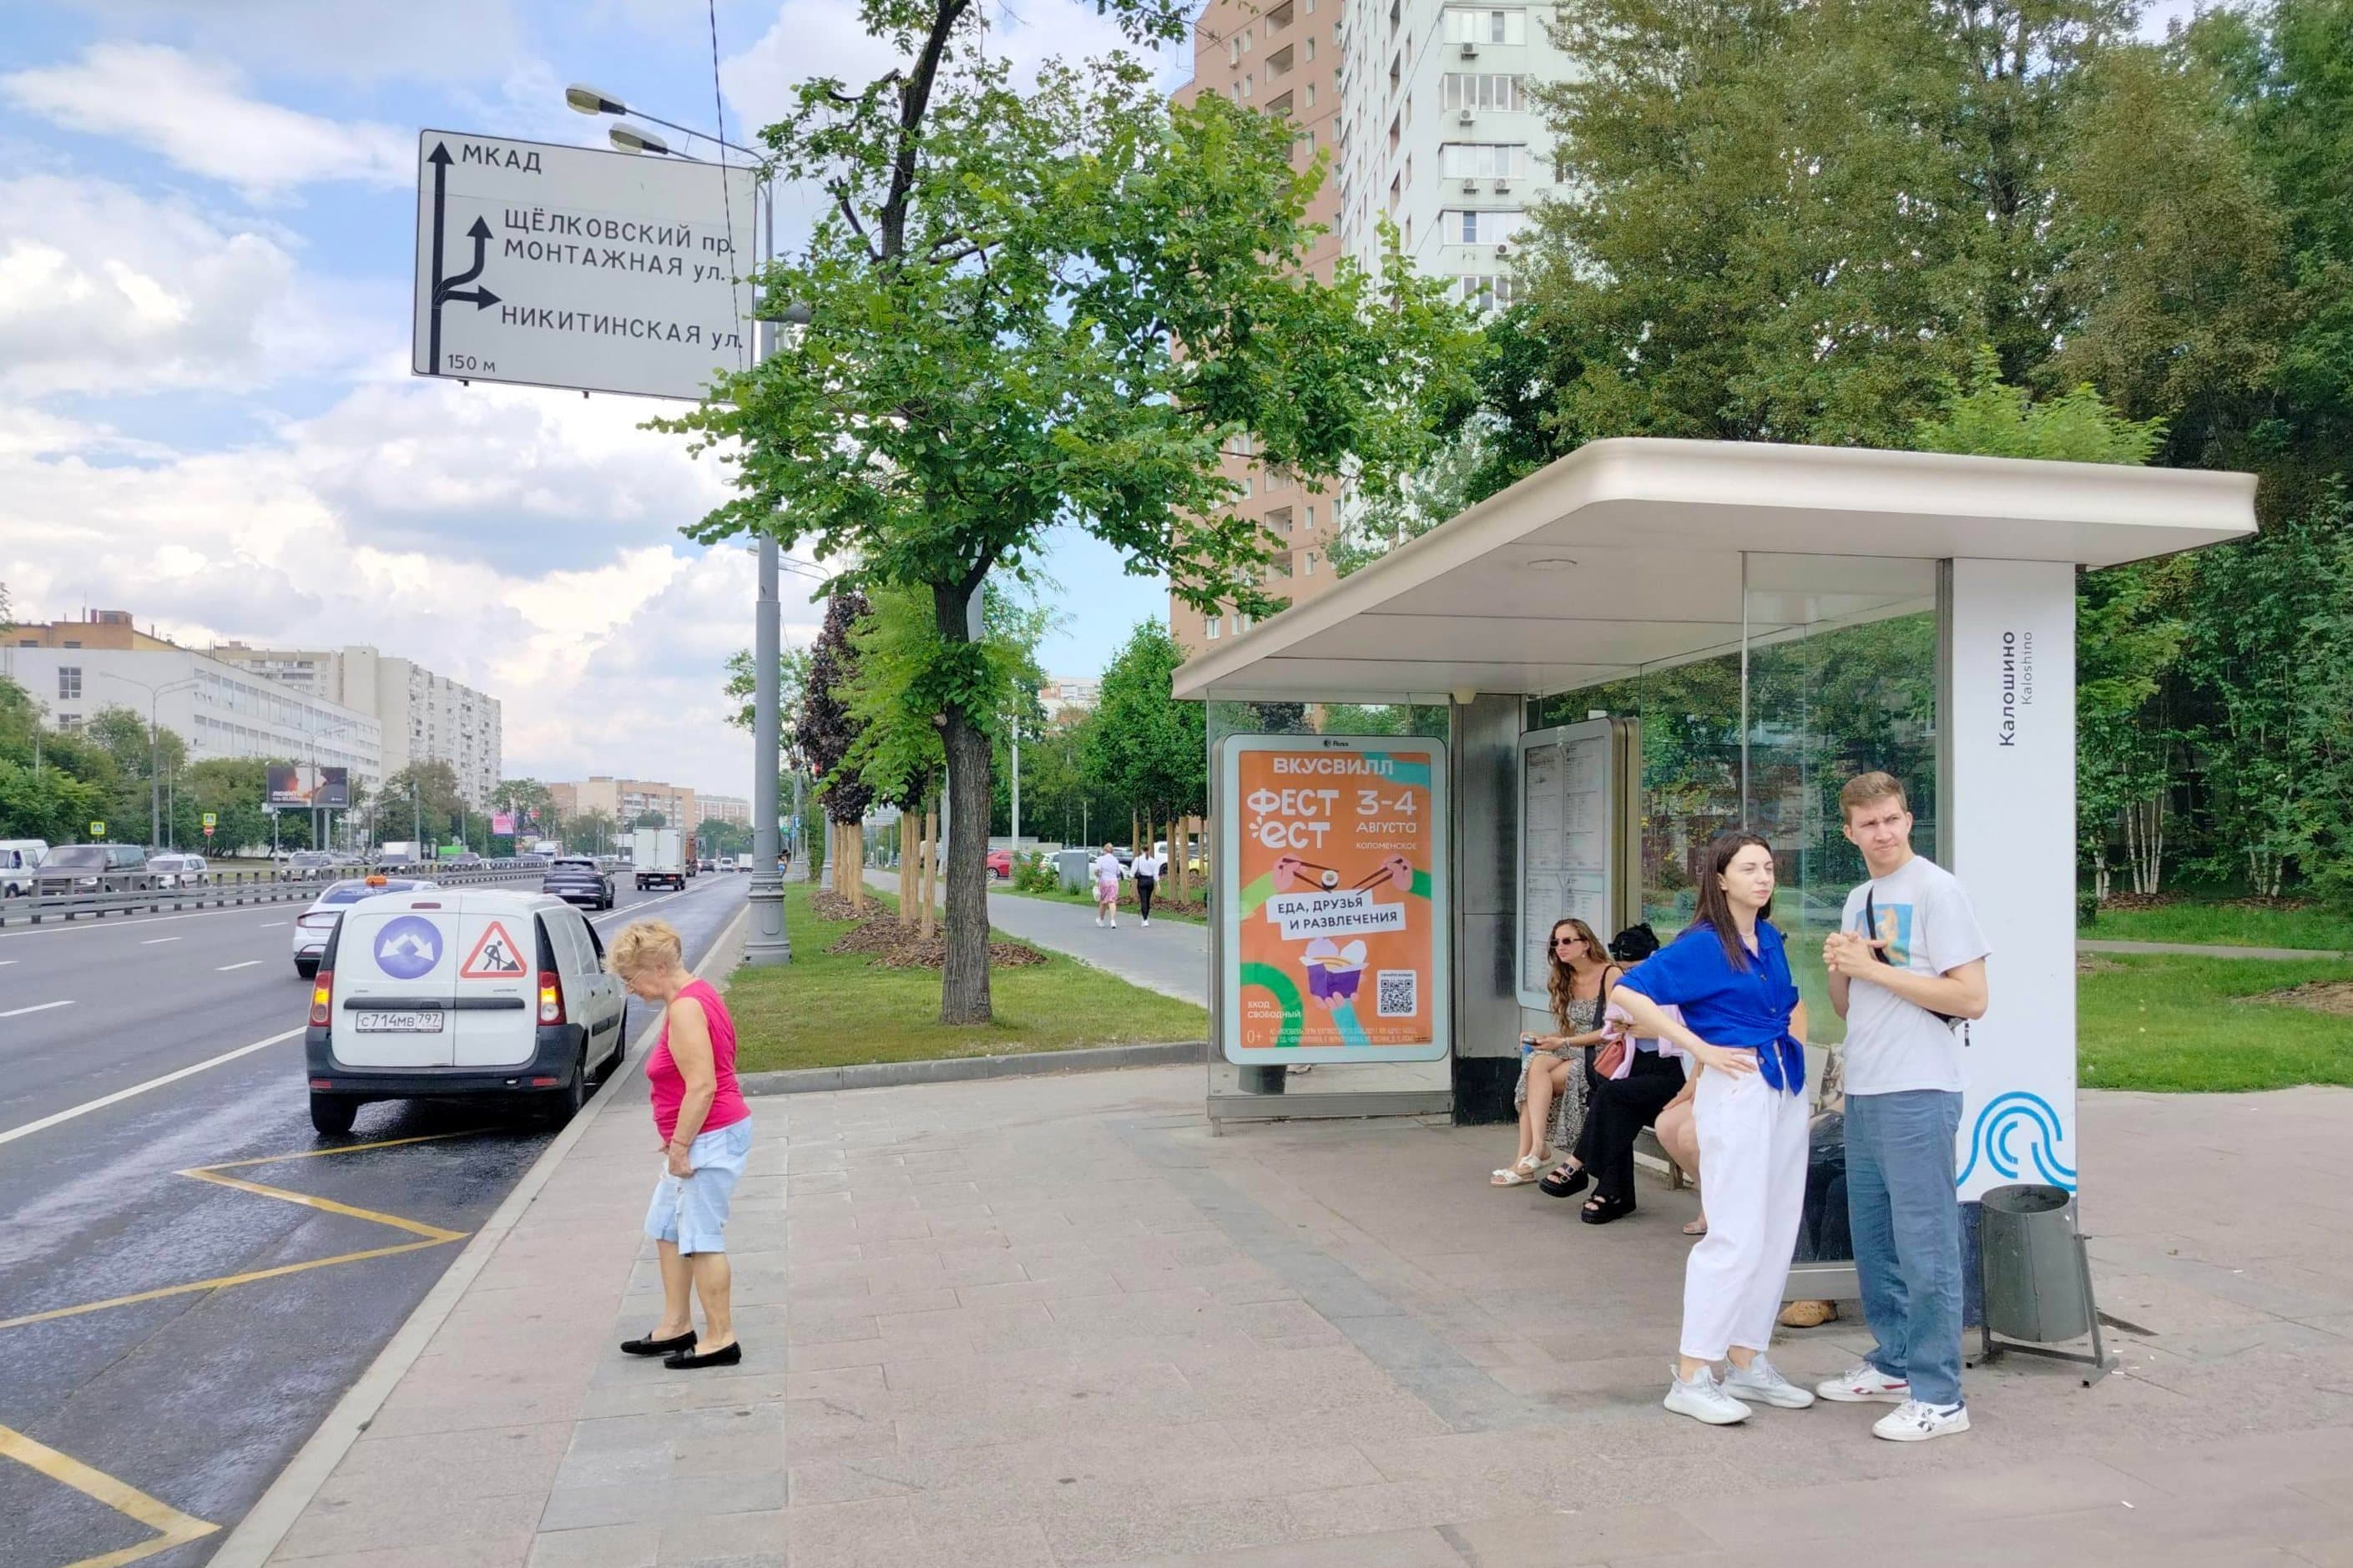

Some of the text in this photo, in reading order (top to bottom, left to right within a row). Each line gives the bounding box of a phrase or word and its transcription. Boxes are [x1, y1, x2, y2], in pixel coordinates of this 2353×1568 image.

[462, 144, 542, 174] МКАД
[504, 207, 736, 255] ЩЁЛКОВСКИЙ пр.
[504, 239, 726, 284] МОНТАЖНАЯ ул.
[501, 305, 744, 351] НИКИТИНСКАЯ ул.
[447, 354, 497, 373] 150 м
[2021, 632, 2032, 705] Kaloshino
[1999, 631, 2016, 746] Калошино
[1273, 757, 1394, 775] ВКУСВИЛЛ
[1247, 788, 1340, 816] ФЕСТ
[1356, 790, 1417, 815] 3-4
[1356, 841, 1416, 850] КОЛОМЕНСКОЕ
[1278, 897, 1363, 915] ЕДА, ДРУЗЬЯ
[1290, 911, 1397, 930] И РАЗВЛЕЧЕНИЯ
[1247, 1010, 1301, 1019] СВОБОДНЫЙ
[1247, 1030, 1263, 1043] 0+
